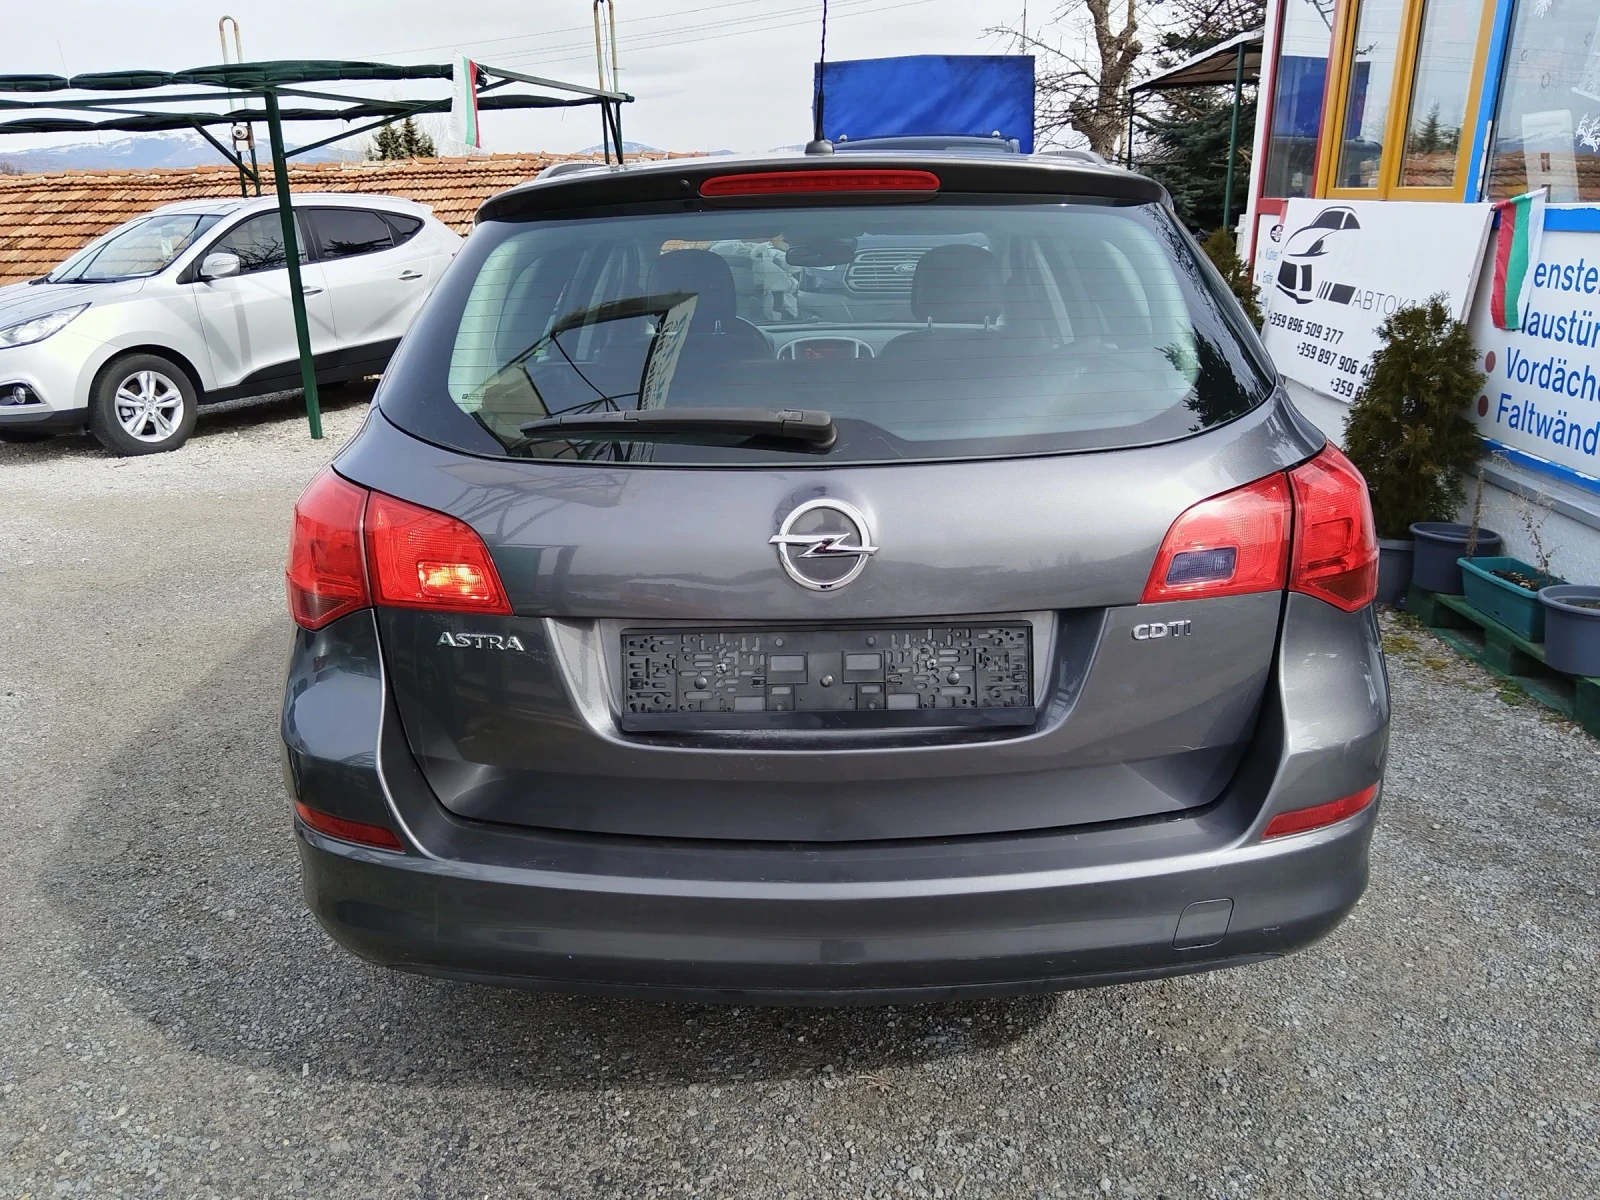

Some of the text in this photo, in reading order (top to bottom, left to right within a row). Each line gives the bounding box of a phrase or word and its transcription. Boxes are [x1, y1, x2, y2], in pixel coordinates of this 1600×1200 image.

[1533, 258, 1600, 295] enste
[1269, 312, 1344, 344] +359 896 509 377
[1297, 341, 1317, 359] +359
[1317, 348, 1338, 366] 897
[1337, 355, 1359, 375] 906
[1330, 377, 1354, 397] +359
[1507, 347, 1600, 404] Vordäch
[436, 631, 525, 652] ASTRA
[1131, 619, 1192, 641] CDTI
